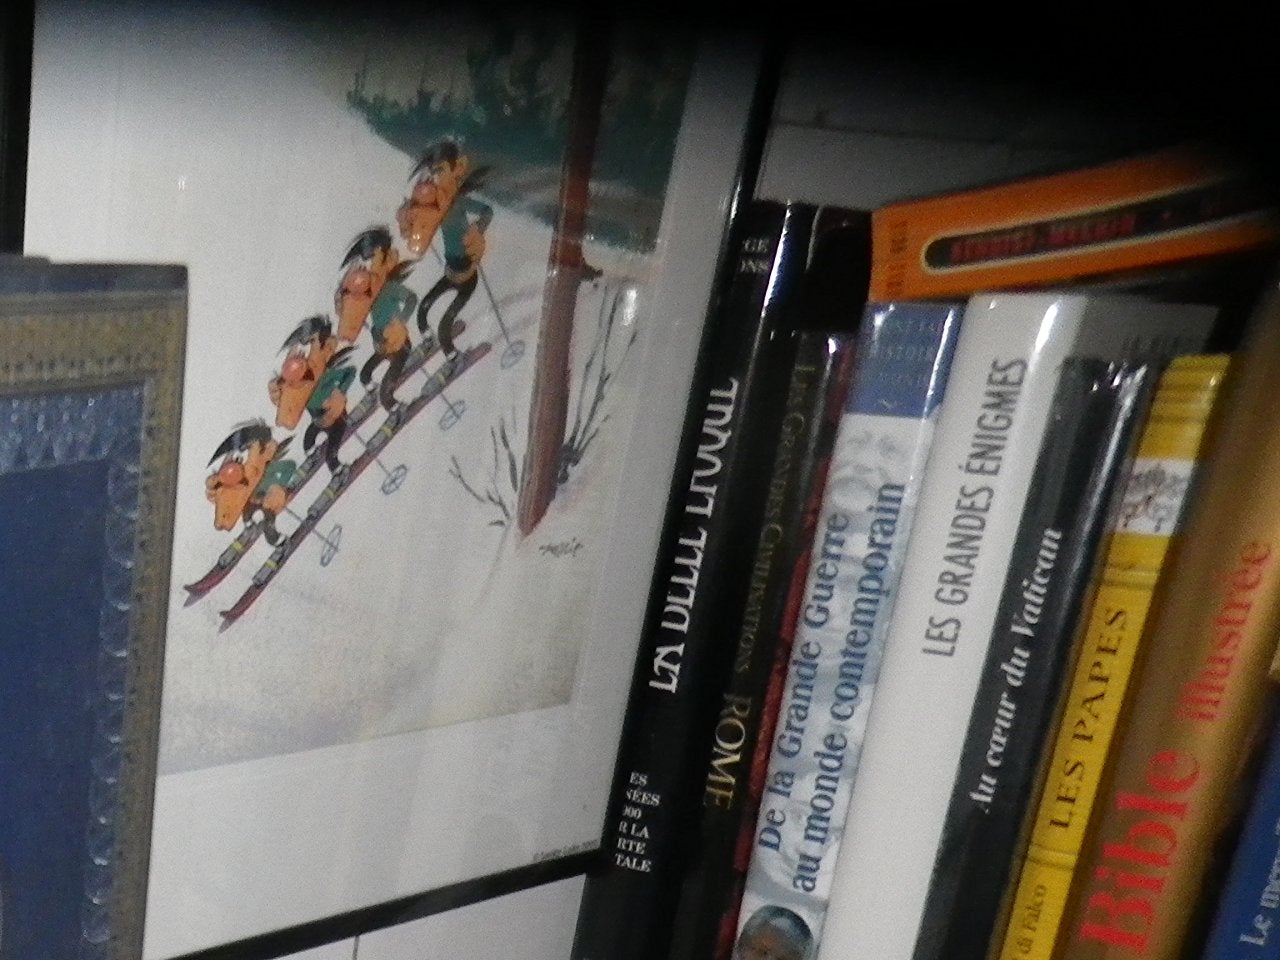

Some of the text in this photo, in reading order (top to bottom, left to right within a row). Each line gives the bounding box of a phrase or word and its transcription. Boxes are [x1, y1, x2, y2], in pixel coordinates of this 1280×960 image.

[922, 357, 1028, 658] LES GRANDES ÉNIGMES
[1011, 527, 1063, 643] Vatican
[759, 512, 850, 851] De la Grande Guerre
[793, 482, 906, 892] au monde contemporain
[1001, 643, 1031, 689] du
[1050, 607, 1127, 830] LES PAPES
[704, 693, 752, 809] ROME
[969, 776, 997, 815] Au
[1023, 883, 1048, 933] Falco
[1078, 748, 1201, 956] Bible
